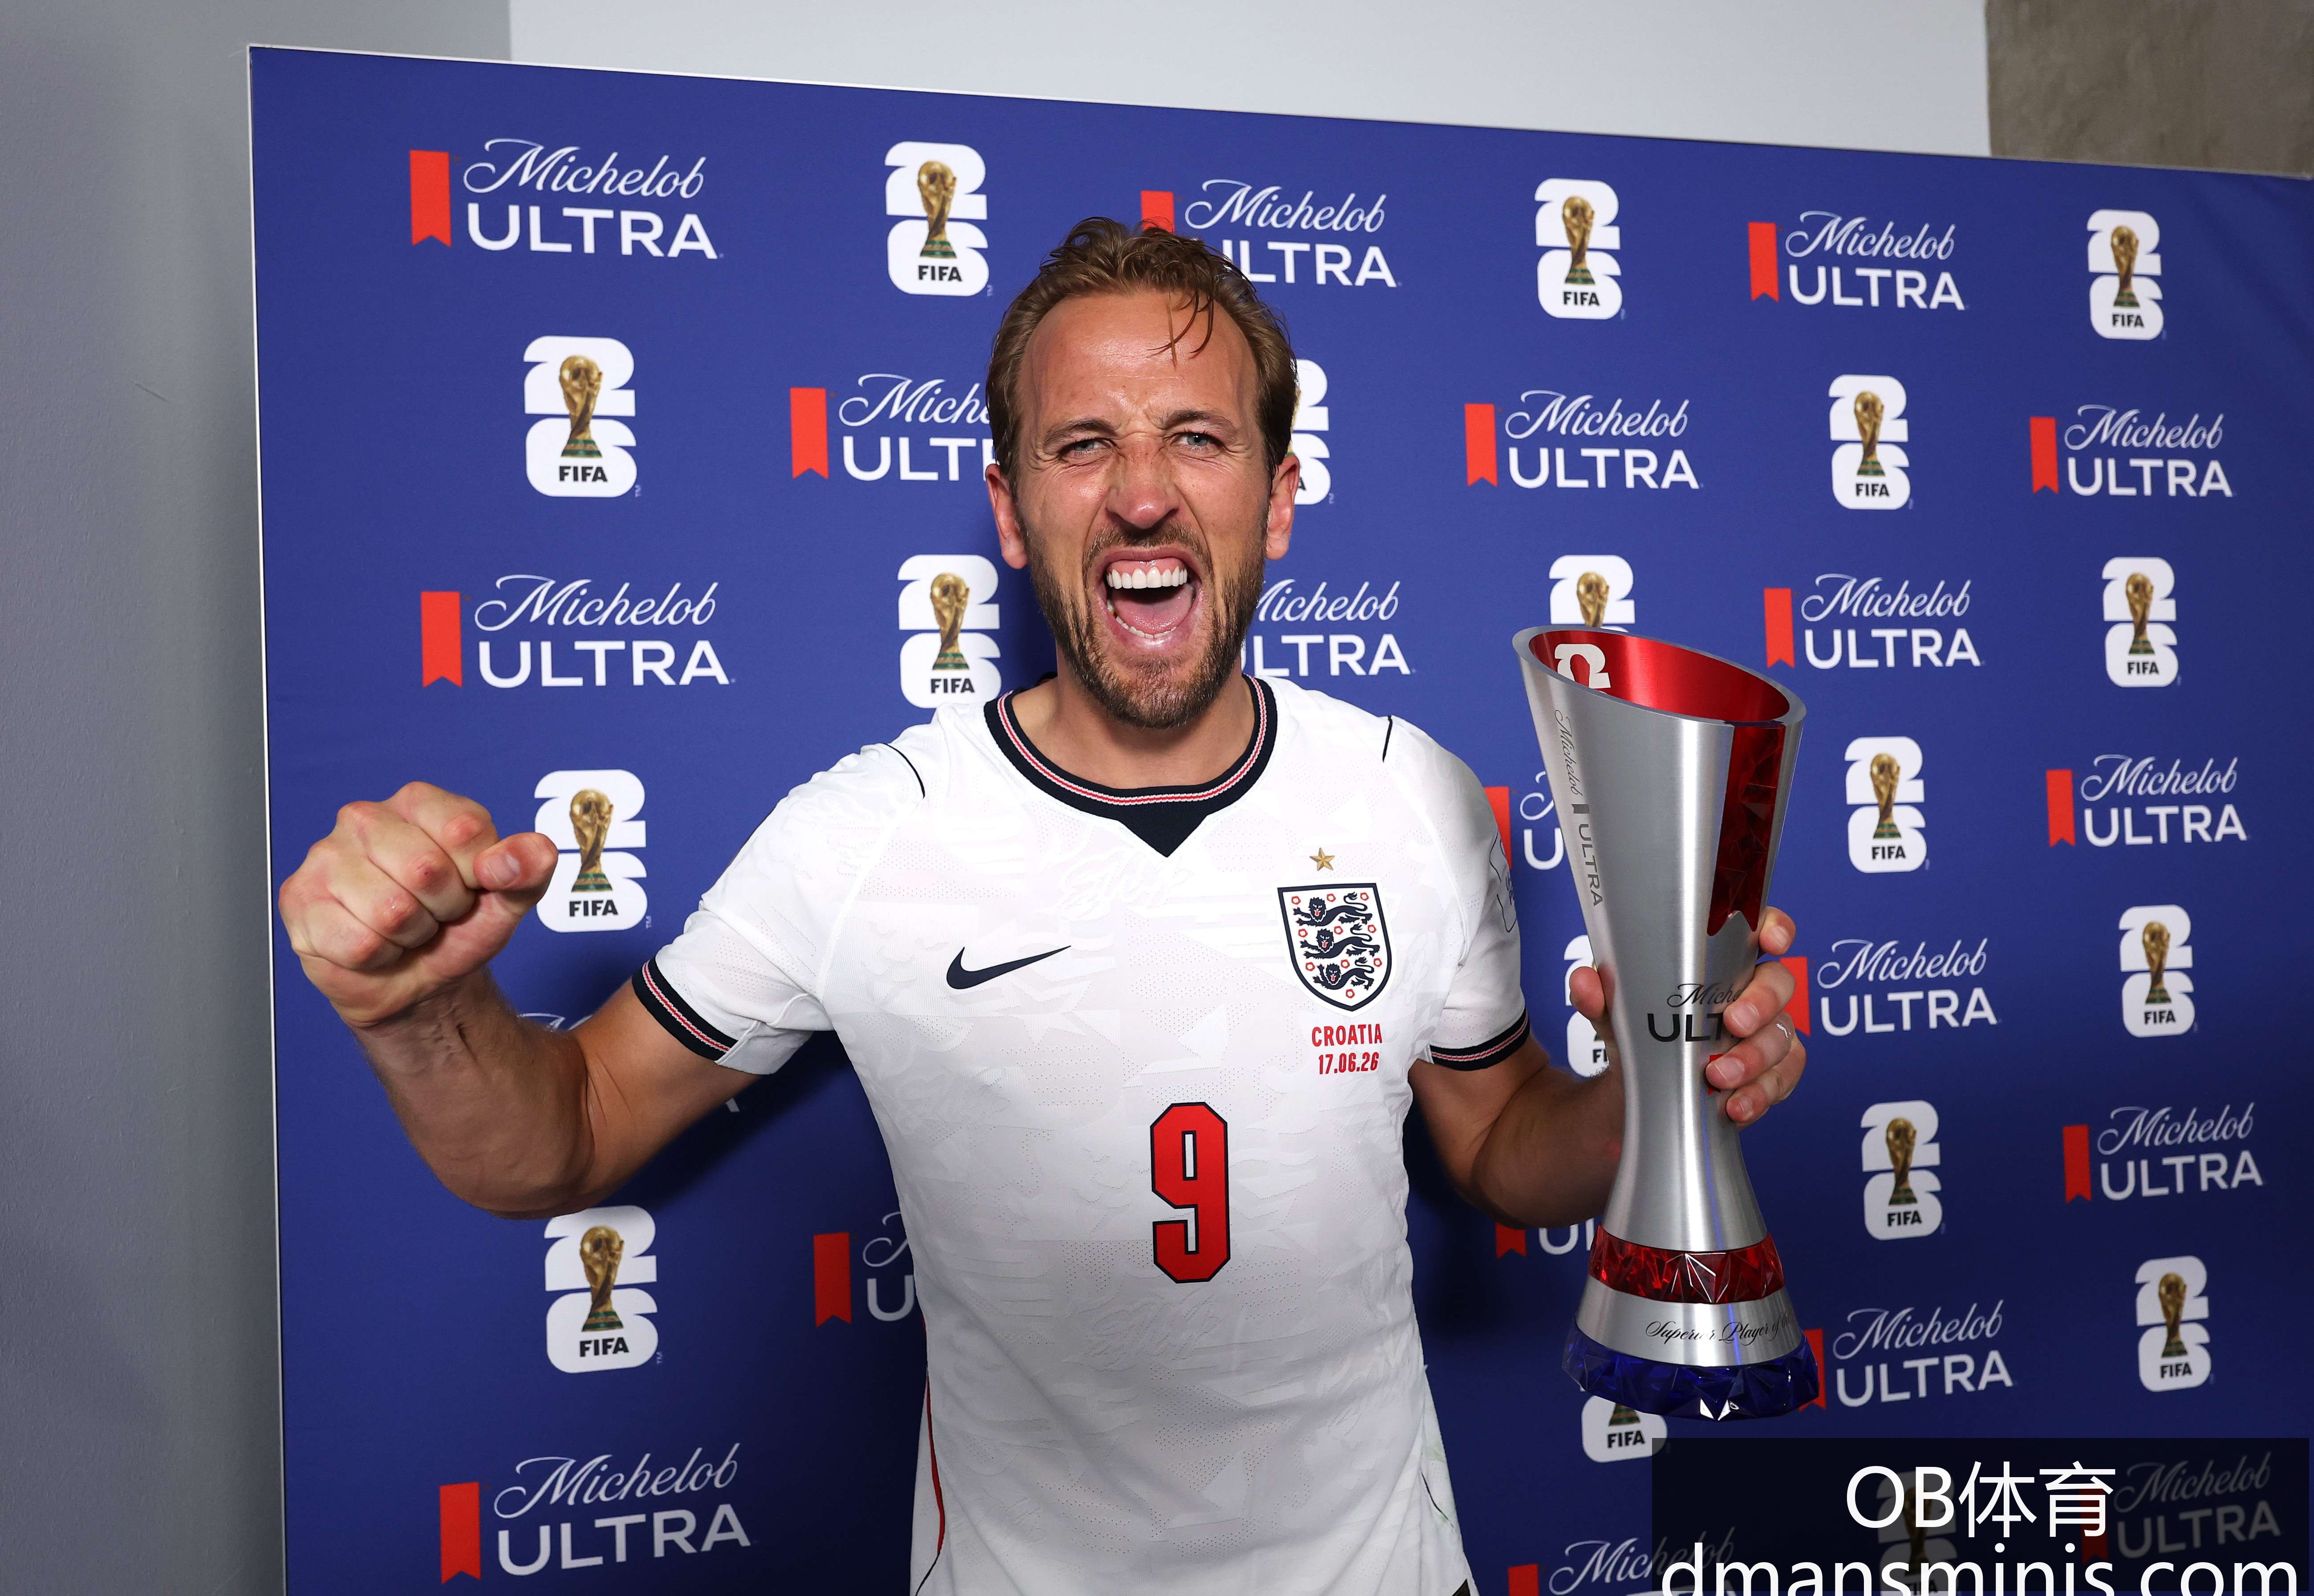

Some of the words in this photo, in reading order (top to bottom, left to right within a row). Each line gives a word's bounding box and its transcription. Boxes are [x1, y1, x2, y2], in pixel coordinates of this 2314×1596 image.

[463, 138, 706, 199] Michelob
[1185, 179, 1387, 233] Michelob
[467, 202, 719, 260] ULTRA
[1785, 211, 1956, 260] Michelob
[918, 265, 962, 282] FIFA
[1222, 239, 1397, 288] LTRA
[1563, 291, 1600, 306] FIFA
[1789, 264, 1965, 311] ULTRA
[2112, 314, 2144, 327] FIFA
[839, 373, 990, 426] Mich
[1505, 390, 1689, 439] Michelob
[2064, 404, 2224, 451] Michelob
[559, 466, 608, 482] FIFA
[843, 435, 994, 482] ULT
[1508, 447, 1700, 489] ULTRA
[2067, 457, 2233, 497] ULTRA
[1855, 483, 1890, 496] FIFA
[474, 574, 719, 631] Michelob
[1801, 573, 1972, 622] Michelob
[479, 640, 730, 688] ULTRA
[1241, 634, 1411, 677] LTRA
[1804, 628, 1981, 670] ULTRA
[2127, 662, 2159, 674] FIFA
[930, 678, 975, 694] FIFA
[1554, 709, 1583, 796] Michelob
[2081, 754, 2238, 801] Michelob
[2084, 804, 2248, 847] ULTRA
[1578, 824, 1604, 907] ULTRA
[1871, 845, 1906, 860] FIFA
[569, 899, 618, 917] FIFA
[1817, 938, 1988, 989] Michelob
[1667, 983, 1742, 1008] Miche
[1820, 987, 1998, 1036] ULTRA
[2144, 1010, 2176, 1024] FIFA
[1312, 1023, 1383, 1047] CROATIA
[1647, 1012, 1724, 1042] ULT
[1319, 1052, 1380, 1075] 17.06.26
[1592, 1048, 1608, 1064] FI
[2097, 1102, 2254, 1155] Michelob
[1150, 1102, 1230, 1282] 9
[2100, 1150, 2263, 1201] ULTRA
[1887, 1210, 1922, 1227] FIFA
[579, 1337, 629, 1357] FIFA
[1645, 1321, 1716, 1345] Superir
[1718, 1321, 1769, 1346] Player
[1832, 1300, 2004, 1360] Michelob
[1836, 1350, 2014, 1407] ULTRA
[2160, 1363, 2192, 1378] FIFA
[1607, 1430, 1646, 1449] FIFA
[493, 1442, 740, 1519] Michelob
[2114, 1452, 2271, 1513] Michelob
[498, 1504, 751, 1576] ULTRA
[2117, 1500, 2282, 1559] ULTRA
